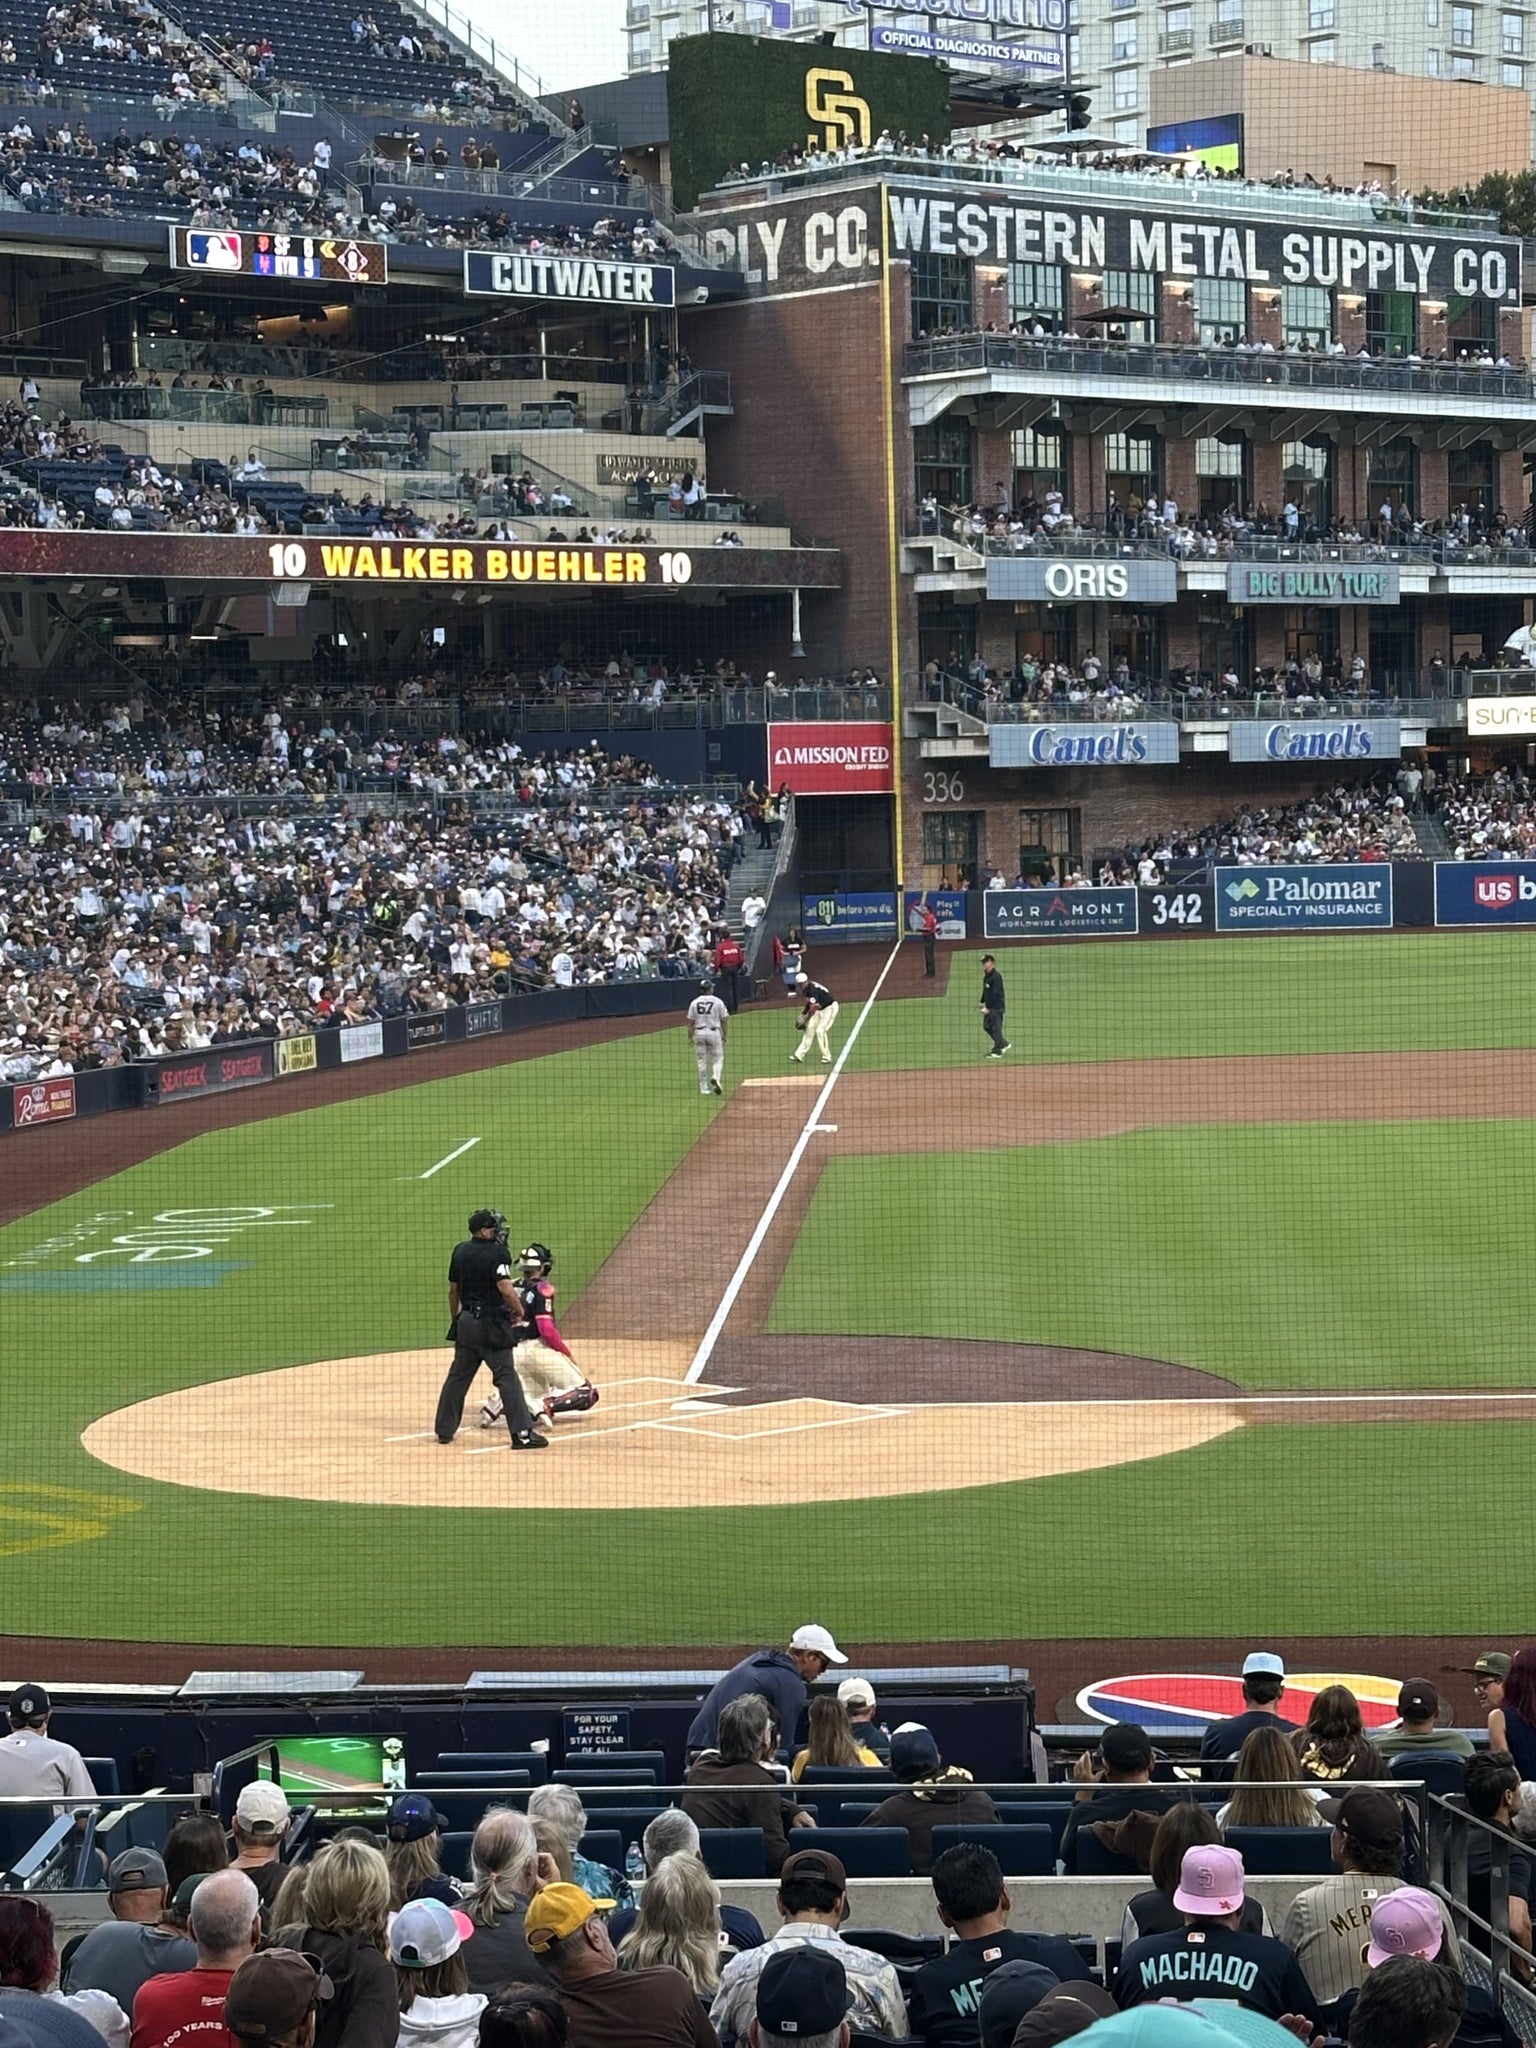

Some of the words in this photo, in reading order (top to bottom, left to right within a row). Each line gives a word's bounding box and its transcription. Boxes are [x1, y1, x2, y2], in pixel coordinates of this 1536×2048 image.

[882, 31, 933, 49] OFFICIAL
[935, 37, 1010, 59] DIAGNOSTICS
[1012, 48, 1061, 65] PARTNER
[274, 235, 291, 256] SF
[805, 206, 880, 273] CO.
[889, 195, 1105, 267] WESTERN
[1130, 219, 1269, 281] METAL
[1282, 233, 1436, 292] SUPPLY
[1453, 248, 1516, 299] CO.
[491, 256, 654, 302] CUTWATER
[269, 543, 307, 578] 10
[321, 545, 474, 579] WALKER
[486, 549, 647, 583] BUEHLER
[658, 551, 692, 584] 10
[1045, 563, 1129, 598] ORIS
[1248, 570, 1281, 598] BIG
[1284, 571, 1341, 598] BULLY
[1341, 571, 1388, 598] TURF
[1029, 724, 1148, 763] Canel's
[1265, 721, 1374, 760] Canel's
[793, 746, 858, 764] MISSION
[861, 746, 889, 763] FED
[923, 771, 964, 803] 336
[1265, 876, 1382, 901] Palomar
[1478, 881, 1512, 901] us
[818, 900, 835, 916] 811
[837, 904, 863, 916] before
[864, 905, 878, 916] you
[1152, 894, 1202, 924] 342
[1229, 905, 1302, 917] SPECIALTY
[1305, 903, 1383, 915] INSURANCE
[999, 919, 1055, 928] WORLDWIDE
[1058, 917, 1105, 926] LOGISTICS
[1108, 917, 1124, 925] INC
[696, 1001, 714, 1015] 67
[574, 1715, 592, 1723] FOR
[594, 1715, 618, 1723] YOUR
[569, 1737, 593, 1745] STAY
[595, 1736, 624, 1744] CLEAR
[1139, 1951, 1259, 1992] MACHADO
[163, 2030, 182, 2048] 100
[182, 2021, 223, 2034] YEARS
